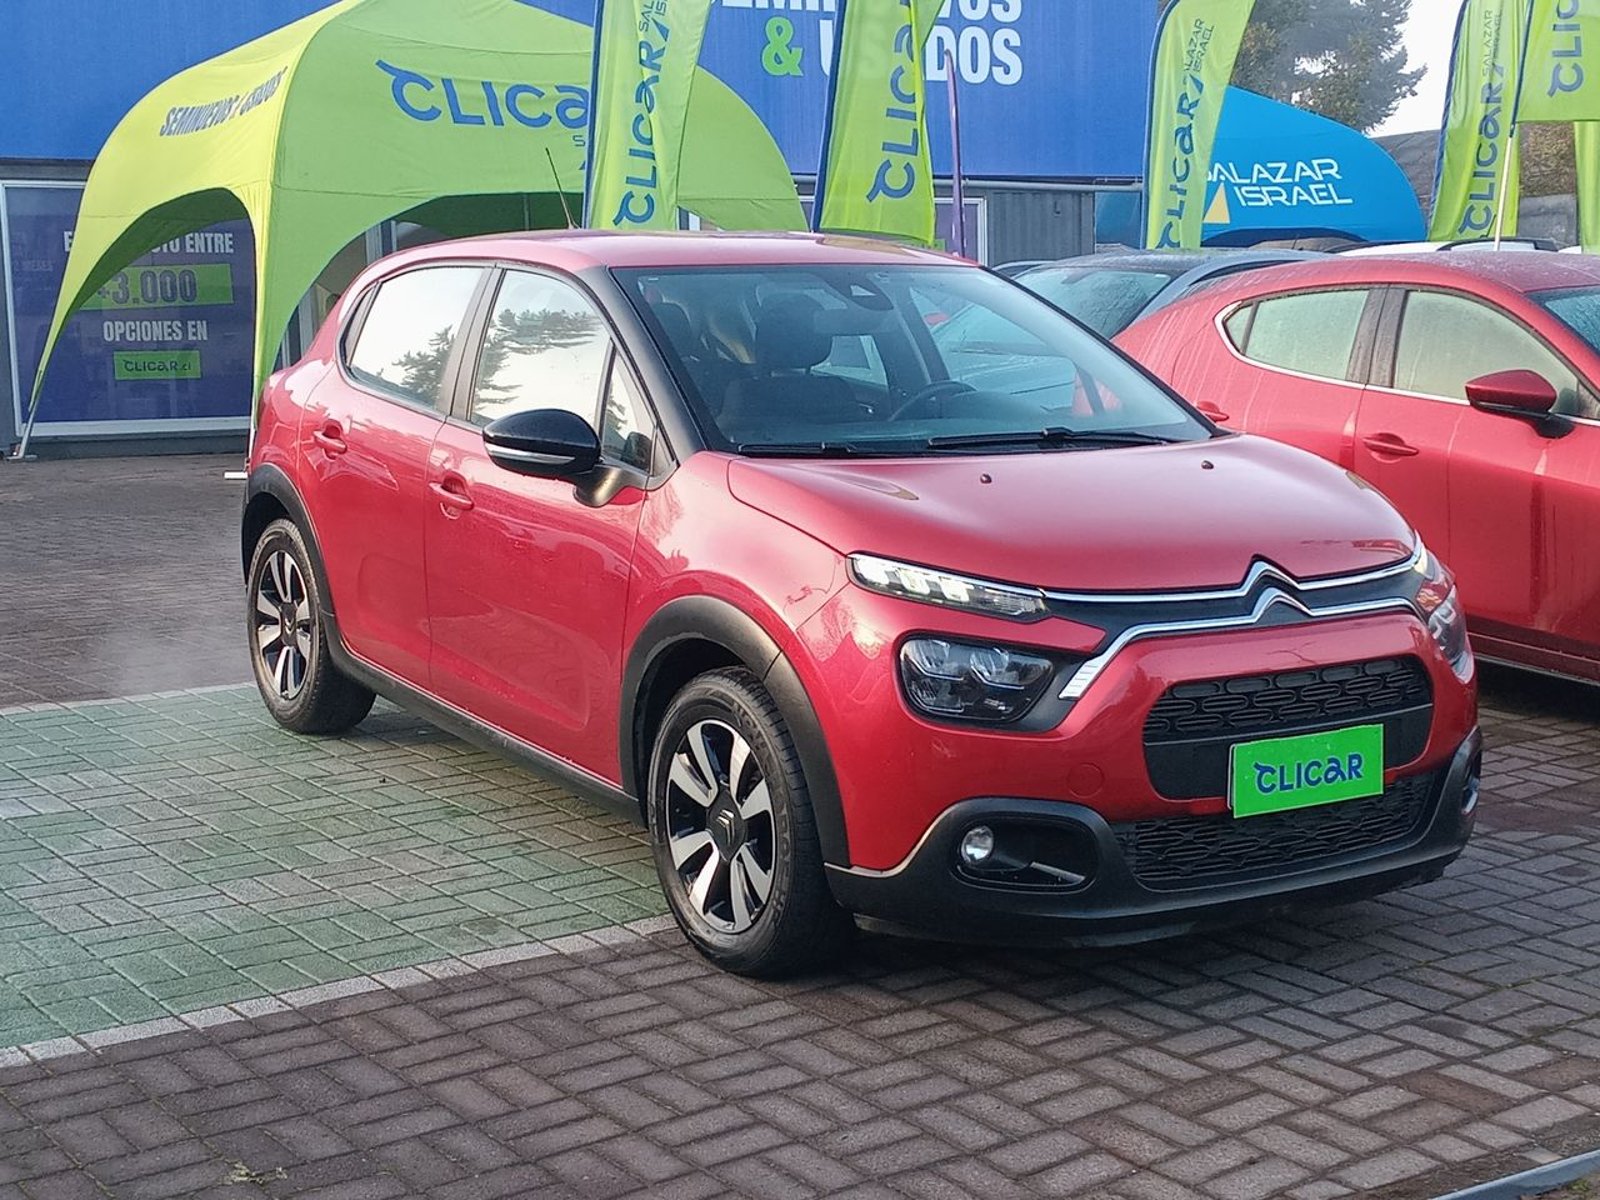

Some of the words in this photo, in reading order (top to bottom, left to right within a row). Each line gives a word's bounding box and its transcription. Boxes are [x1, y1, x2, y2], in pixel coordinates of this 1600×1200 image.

[1207, 158, 1343, 184] ALAZAR
[1233, 183, 1354, 207] ISRAEL
[185, 232, 234, 254] ENTRE
[103, 320, 183, 342] OPCIONES
[187, 320, 208, 341] EN
